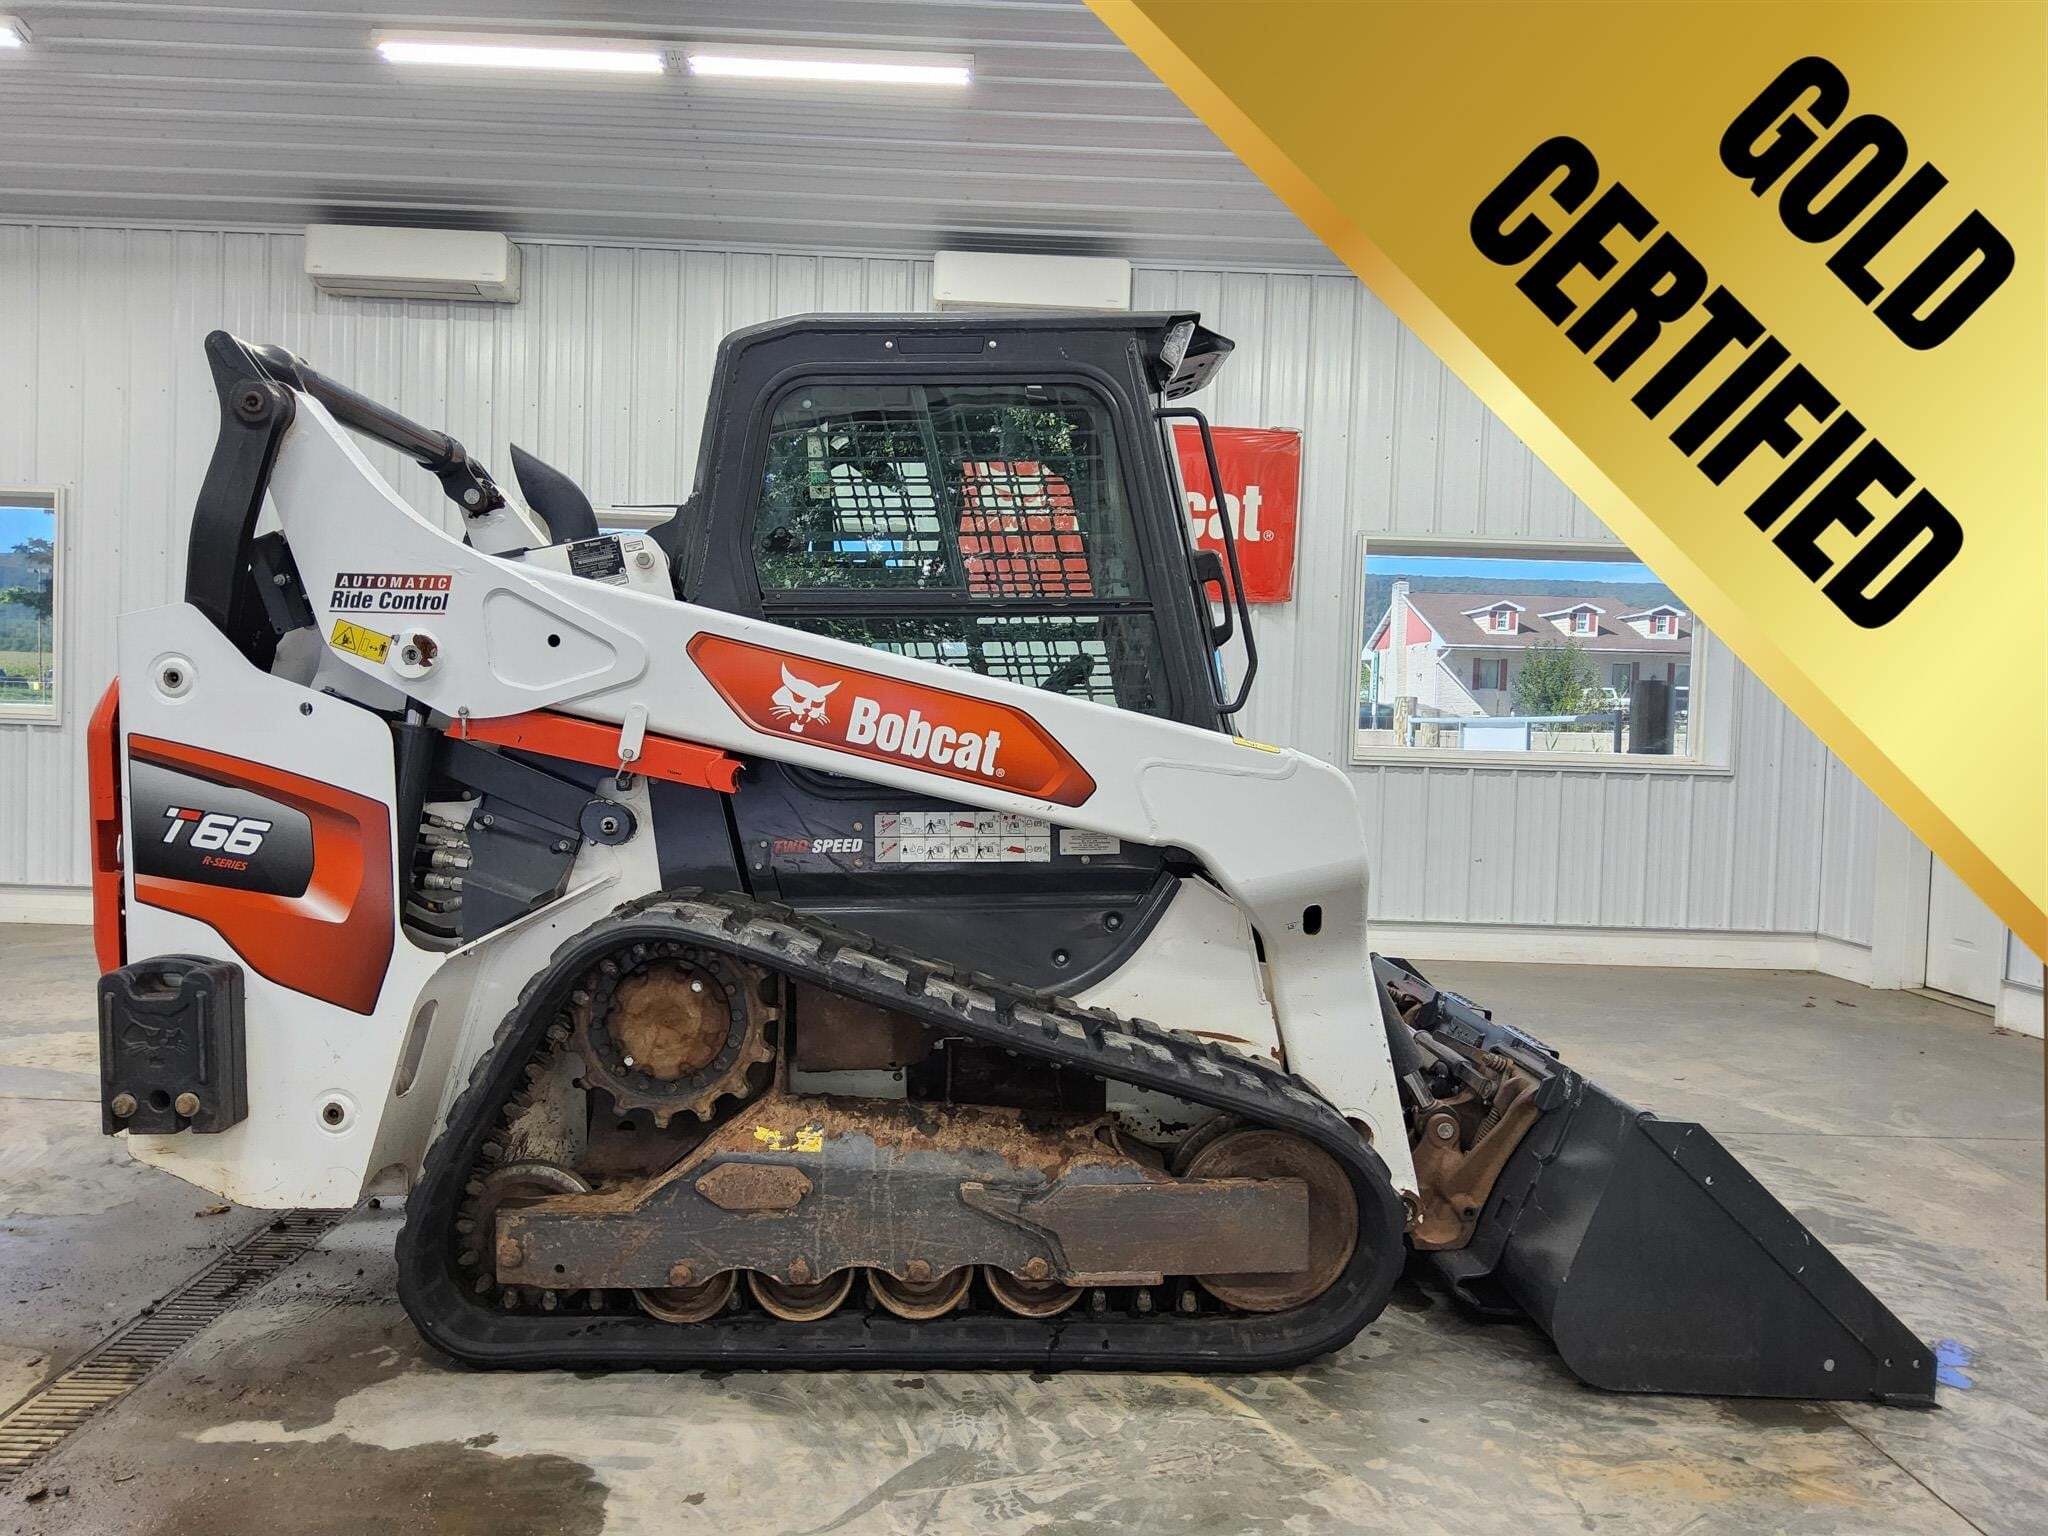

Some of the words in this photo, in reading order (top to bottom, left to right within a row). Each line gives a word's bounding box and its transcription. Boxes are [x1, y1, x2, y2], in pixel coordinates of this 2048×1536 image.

[339, 575, 448, 589] AUTOMATIC
[330, 590, 374, 609] Ride
[378, 591, 449, 611] Control
[162, 806, 273, 856] T66
[811, 838, 863, 854] SPEED
[202, 855, 249, 872] R-SERIES
